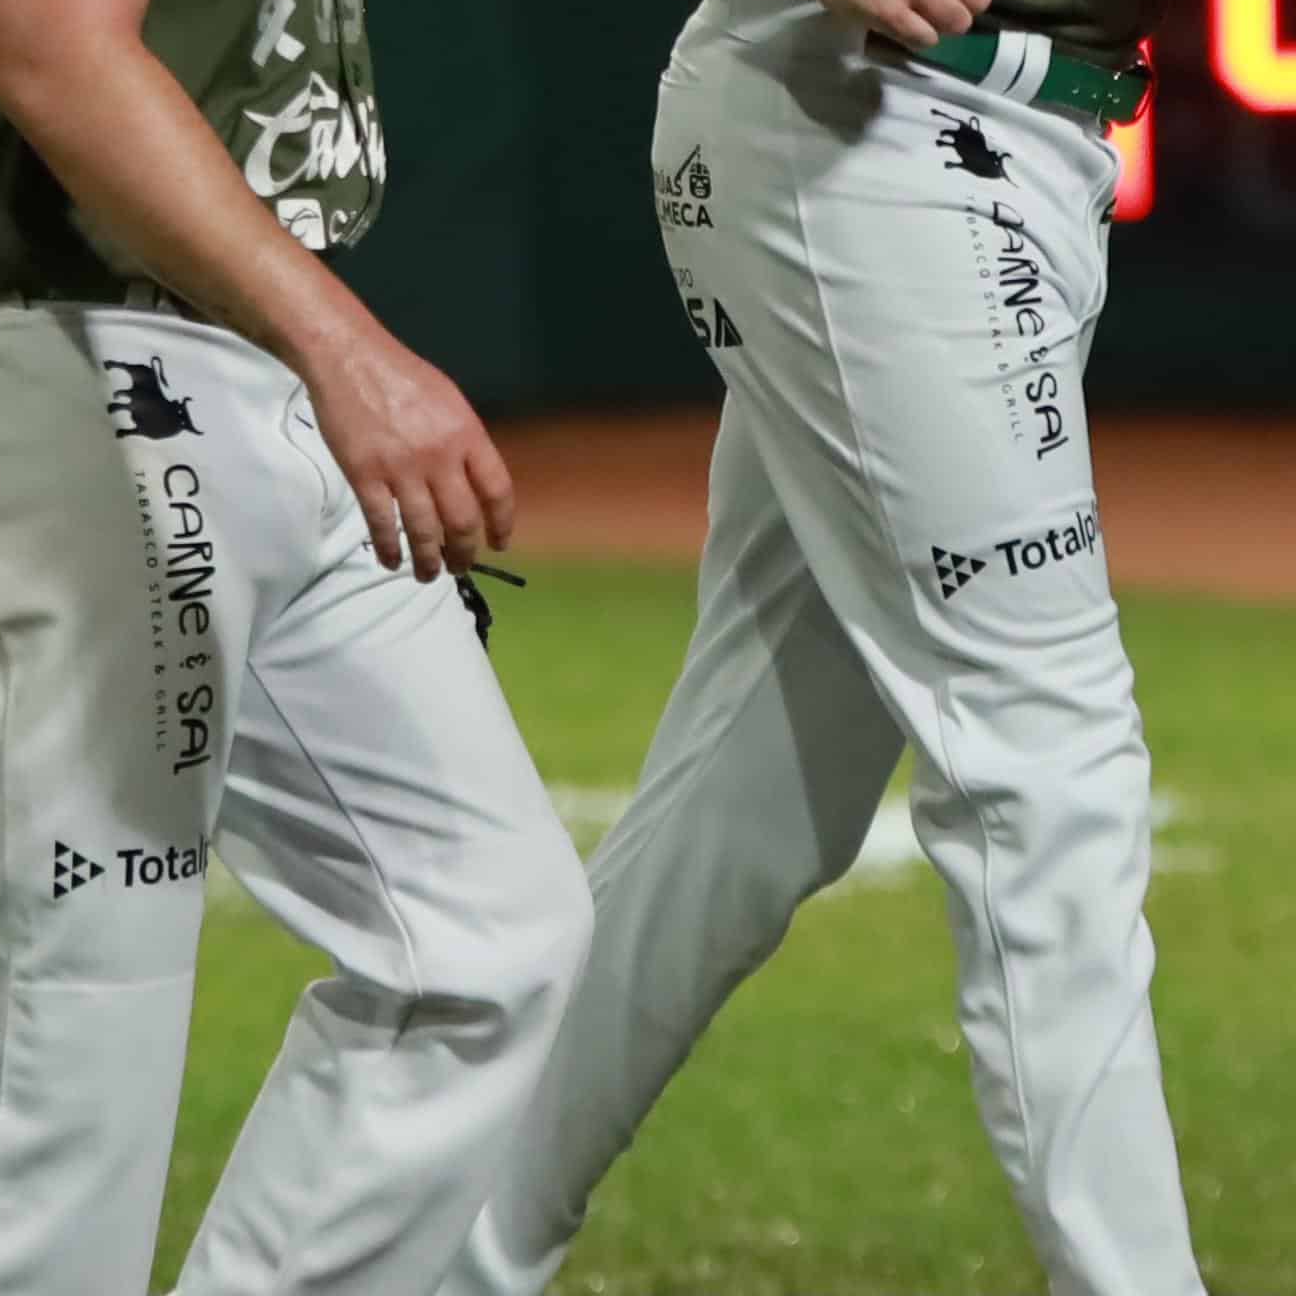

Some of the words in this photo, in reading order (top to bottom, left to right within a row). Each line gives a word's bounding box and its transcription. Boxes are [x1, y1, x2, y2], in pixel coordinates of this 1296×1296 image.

[965, 194, 991, 279] TBASCO
[1025, 372, 1069, 460] SAL
[134, 471, 159, 569] TABASCO
[148, 583, 164, 649] STEAK
[155, 689, 167, 752] GRILL
[173, 684, 214, 776] SAL
